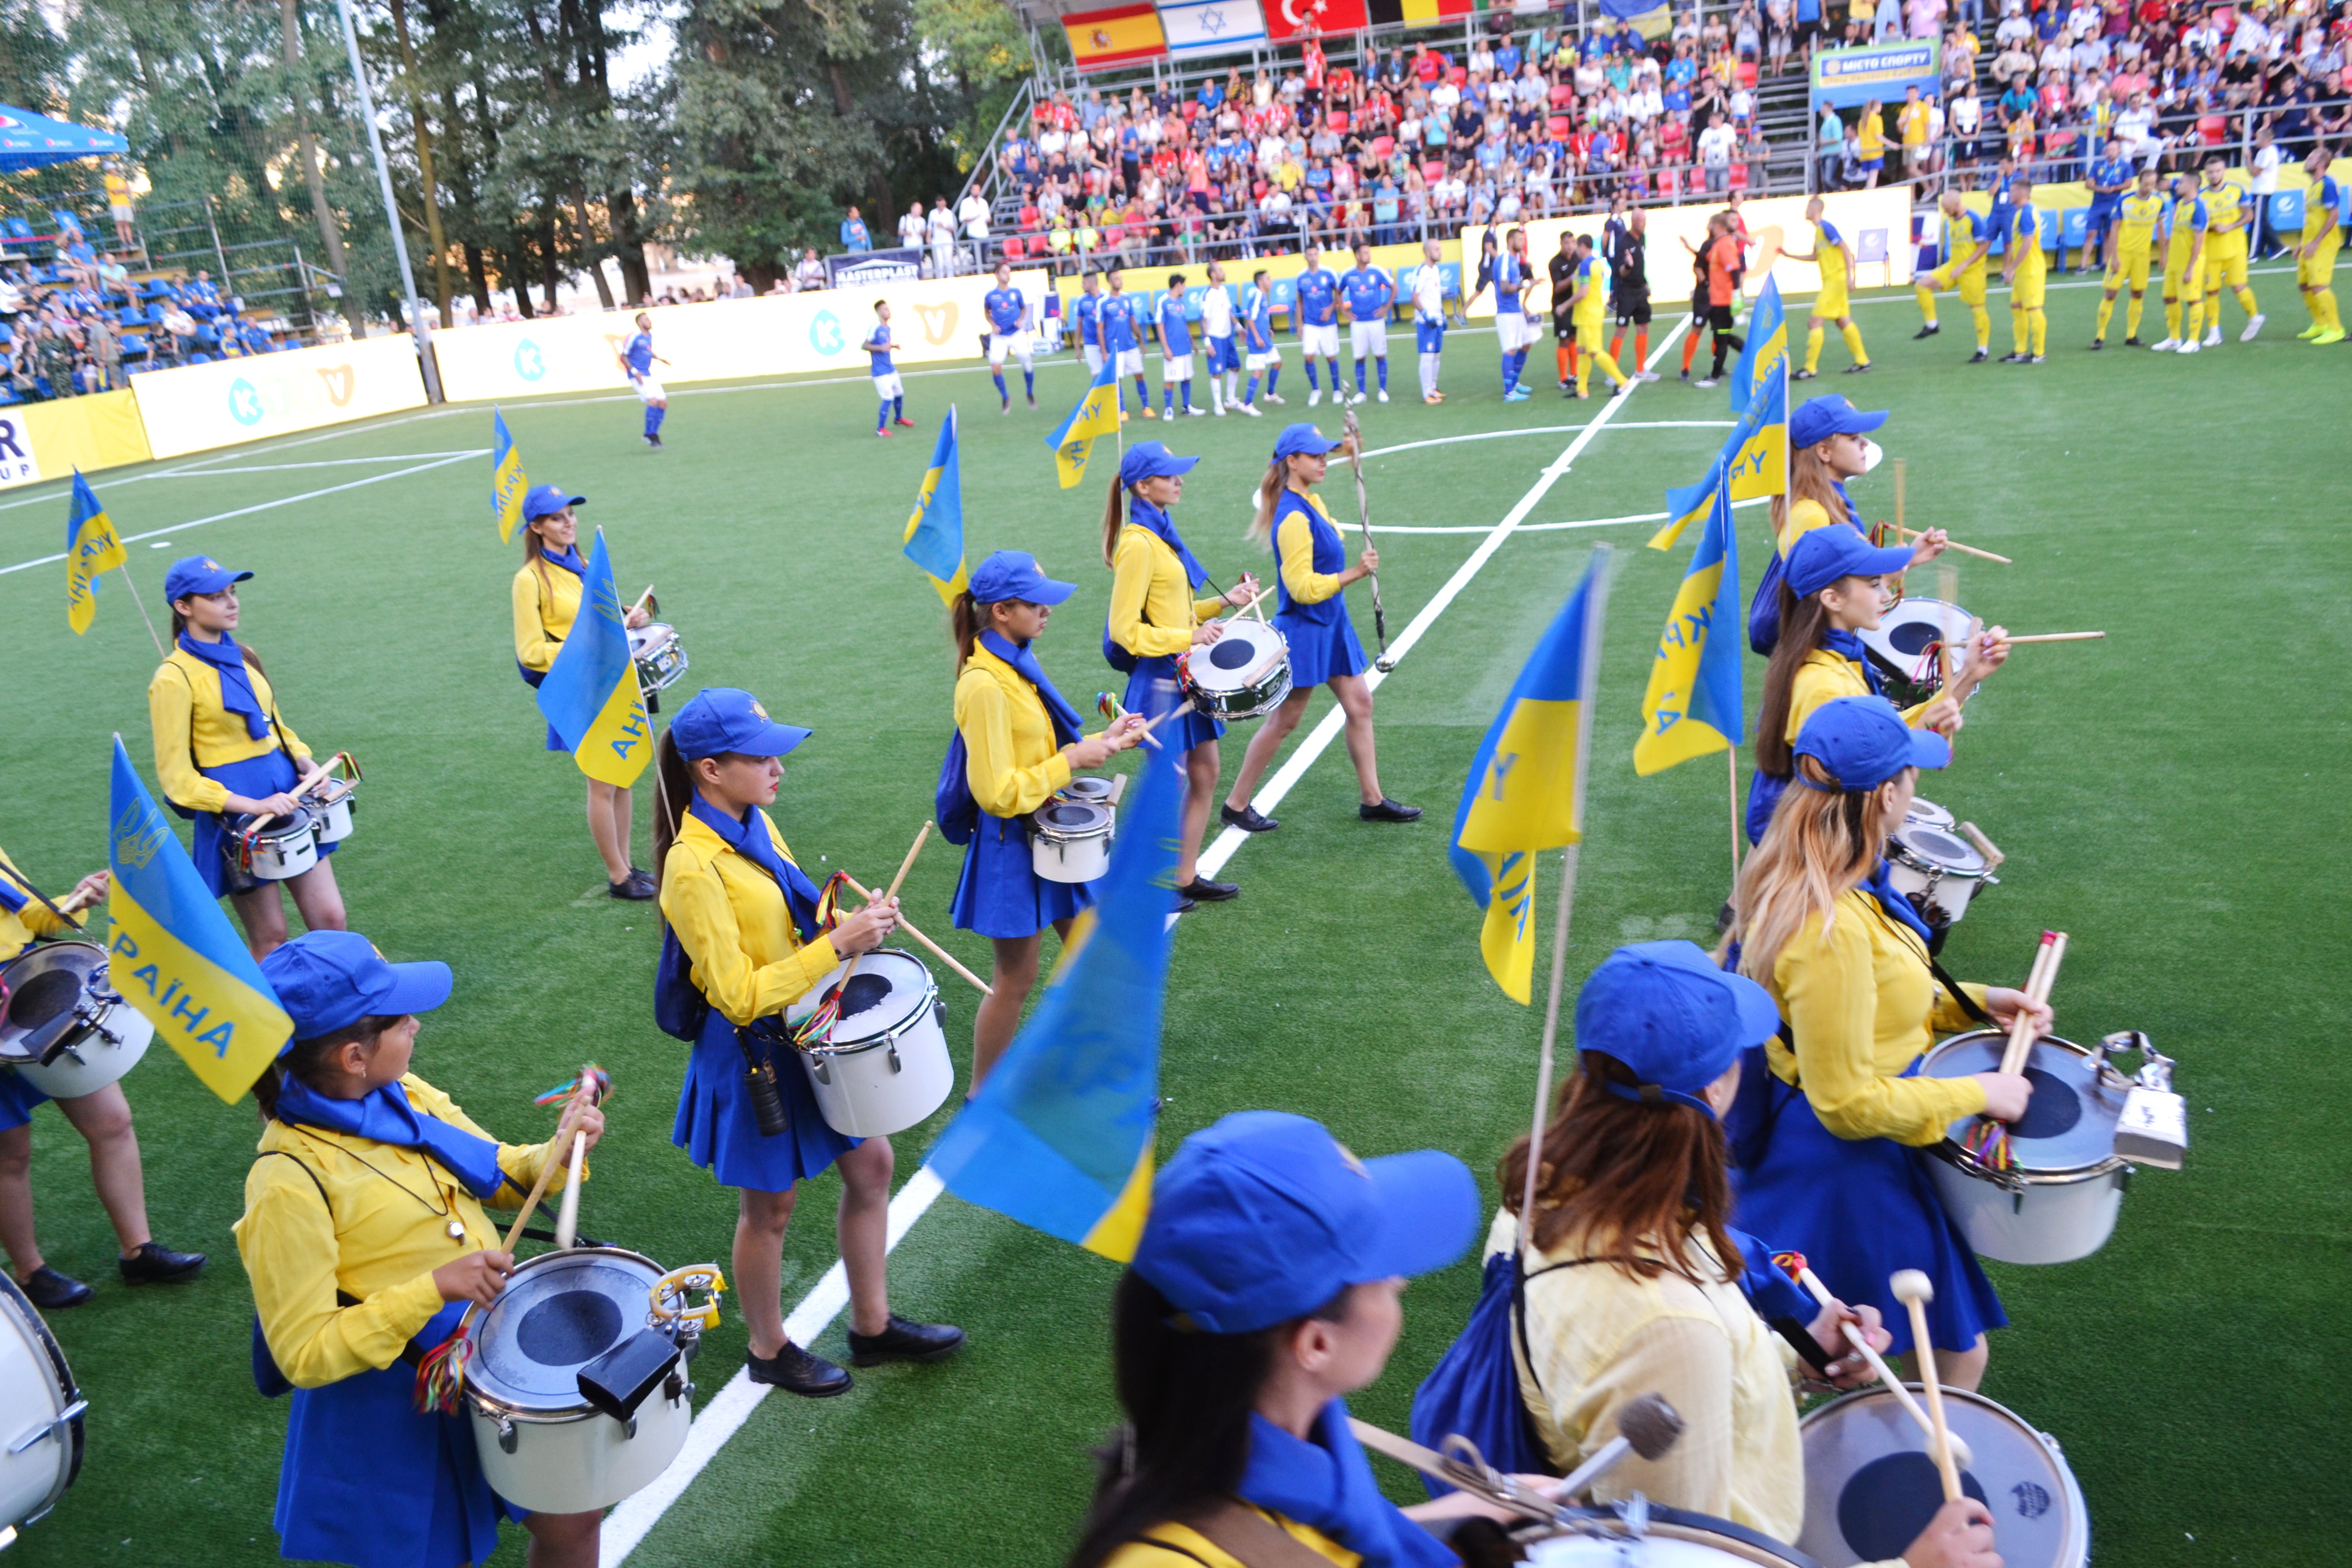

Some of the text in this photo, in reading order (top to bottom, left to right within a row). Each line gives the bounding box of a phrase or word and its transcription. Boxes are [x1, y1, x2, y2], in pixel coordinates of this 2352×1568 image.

[1842, 57, 1879, 72] МІСТО
[835, 264, 919, 282] MASTERPLAST
[108, 916, 236, 1059] РАЇНА
